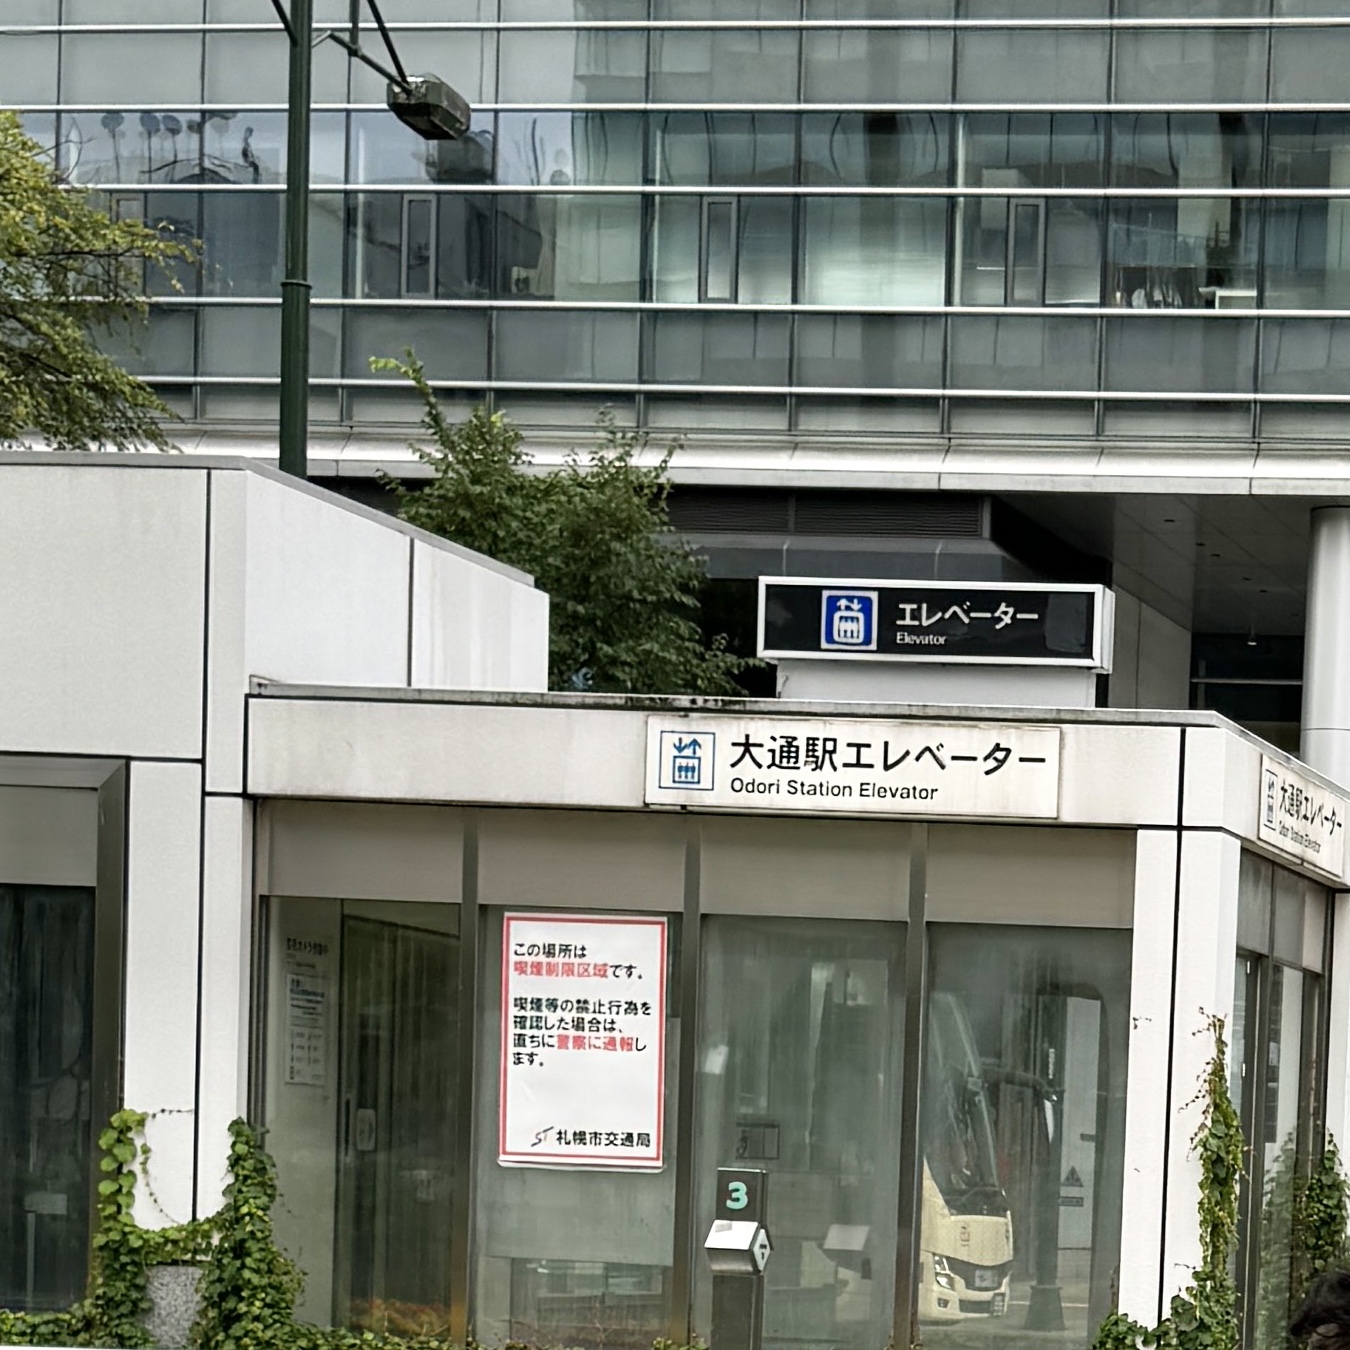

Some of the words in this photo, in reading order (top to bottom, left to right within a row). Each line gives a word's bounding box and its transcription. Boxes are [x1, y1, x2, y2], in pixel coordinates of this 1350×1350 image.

[896, 601, 1039, 630] エレベーター
[896, 632, 947, 645] Elevator
[730, 734, 1046, 776] 大通駅エレベーター
[730, 777, 780, 794] Odori
[787, 780, 852, 797] Station
[859, 782, 938, 800] Elevator
[514, 943, 587, 959] この場所は
[513, 961, 643, 980] 喫煙制限区域です。
[513, 997, 652, 1016] 喫煙等の禁止行為を
[513, 1015, 624, 1034] 確認した場合は、
[513, 1034, 647, 1052] 直ちに警察に通報し
[513, 1052, 544, 1067] ます。
[556, 1129, 651, 1148] 札幌市交通局
[725, 1181, 749, 1210] 3
